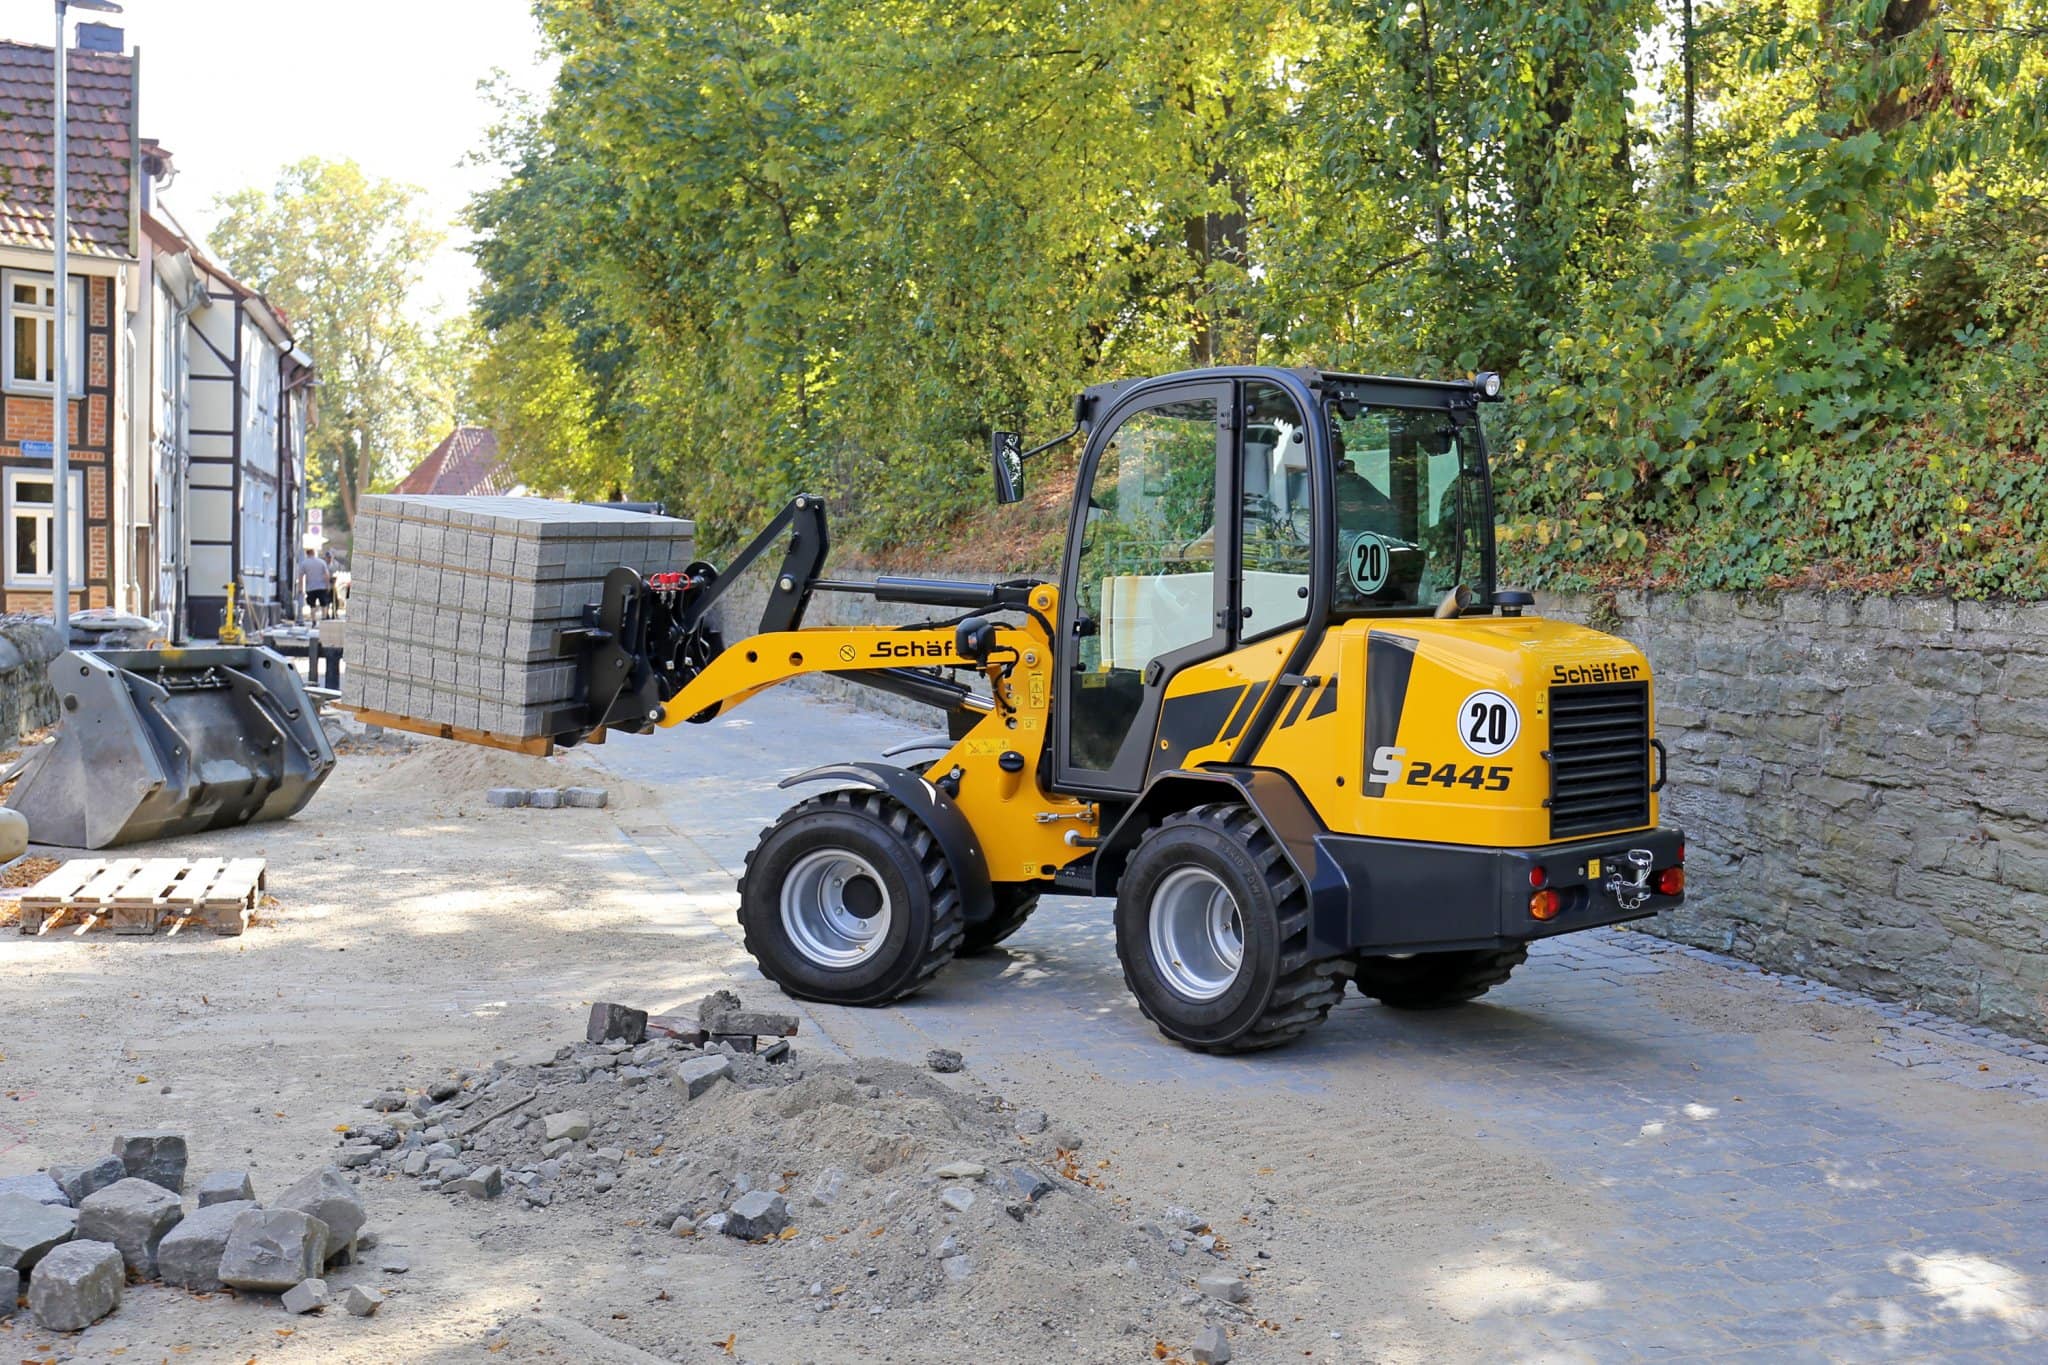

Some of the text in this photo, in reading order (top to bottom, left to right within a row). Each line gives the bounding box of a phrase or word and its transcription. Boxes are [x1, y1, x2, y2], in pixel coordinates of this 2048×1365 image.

[1357, 543, 1381, 582] 20
[869, 641, 957, 657] Schäf
[1552, 662, 1639, 684] Schäffer
[1469, 702, 1507, 745] 20
[1369, 745, 1513, 791] S 2445
